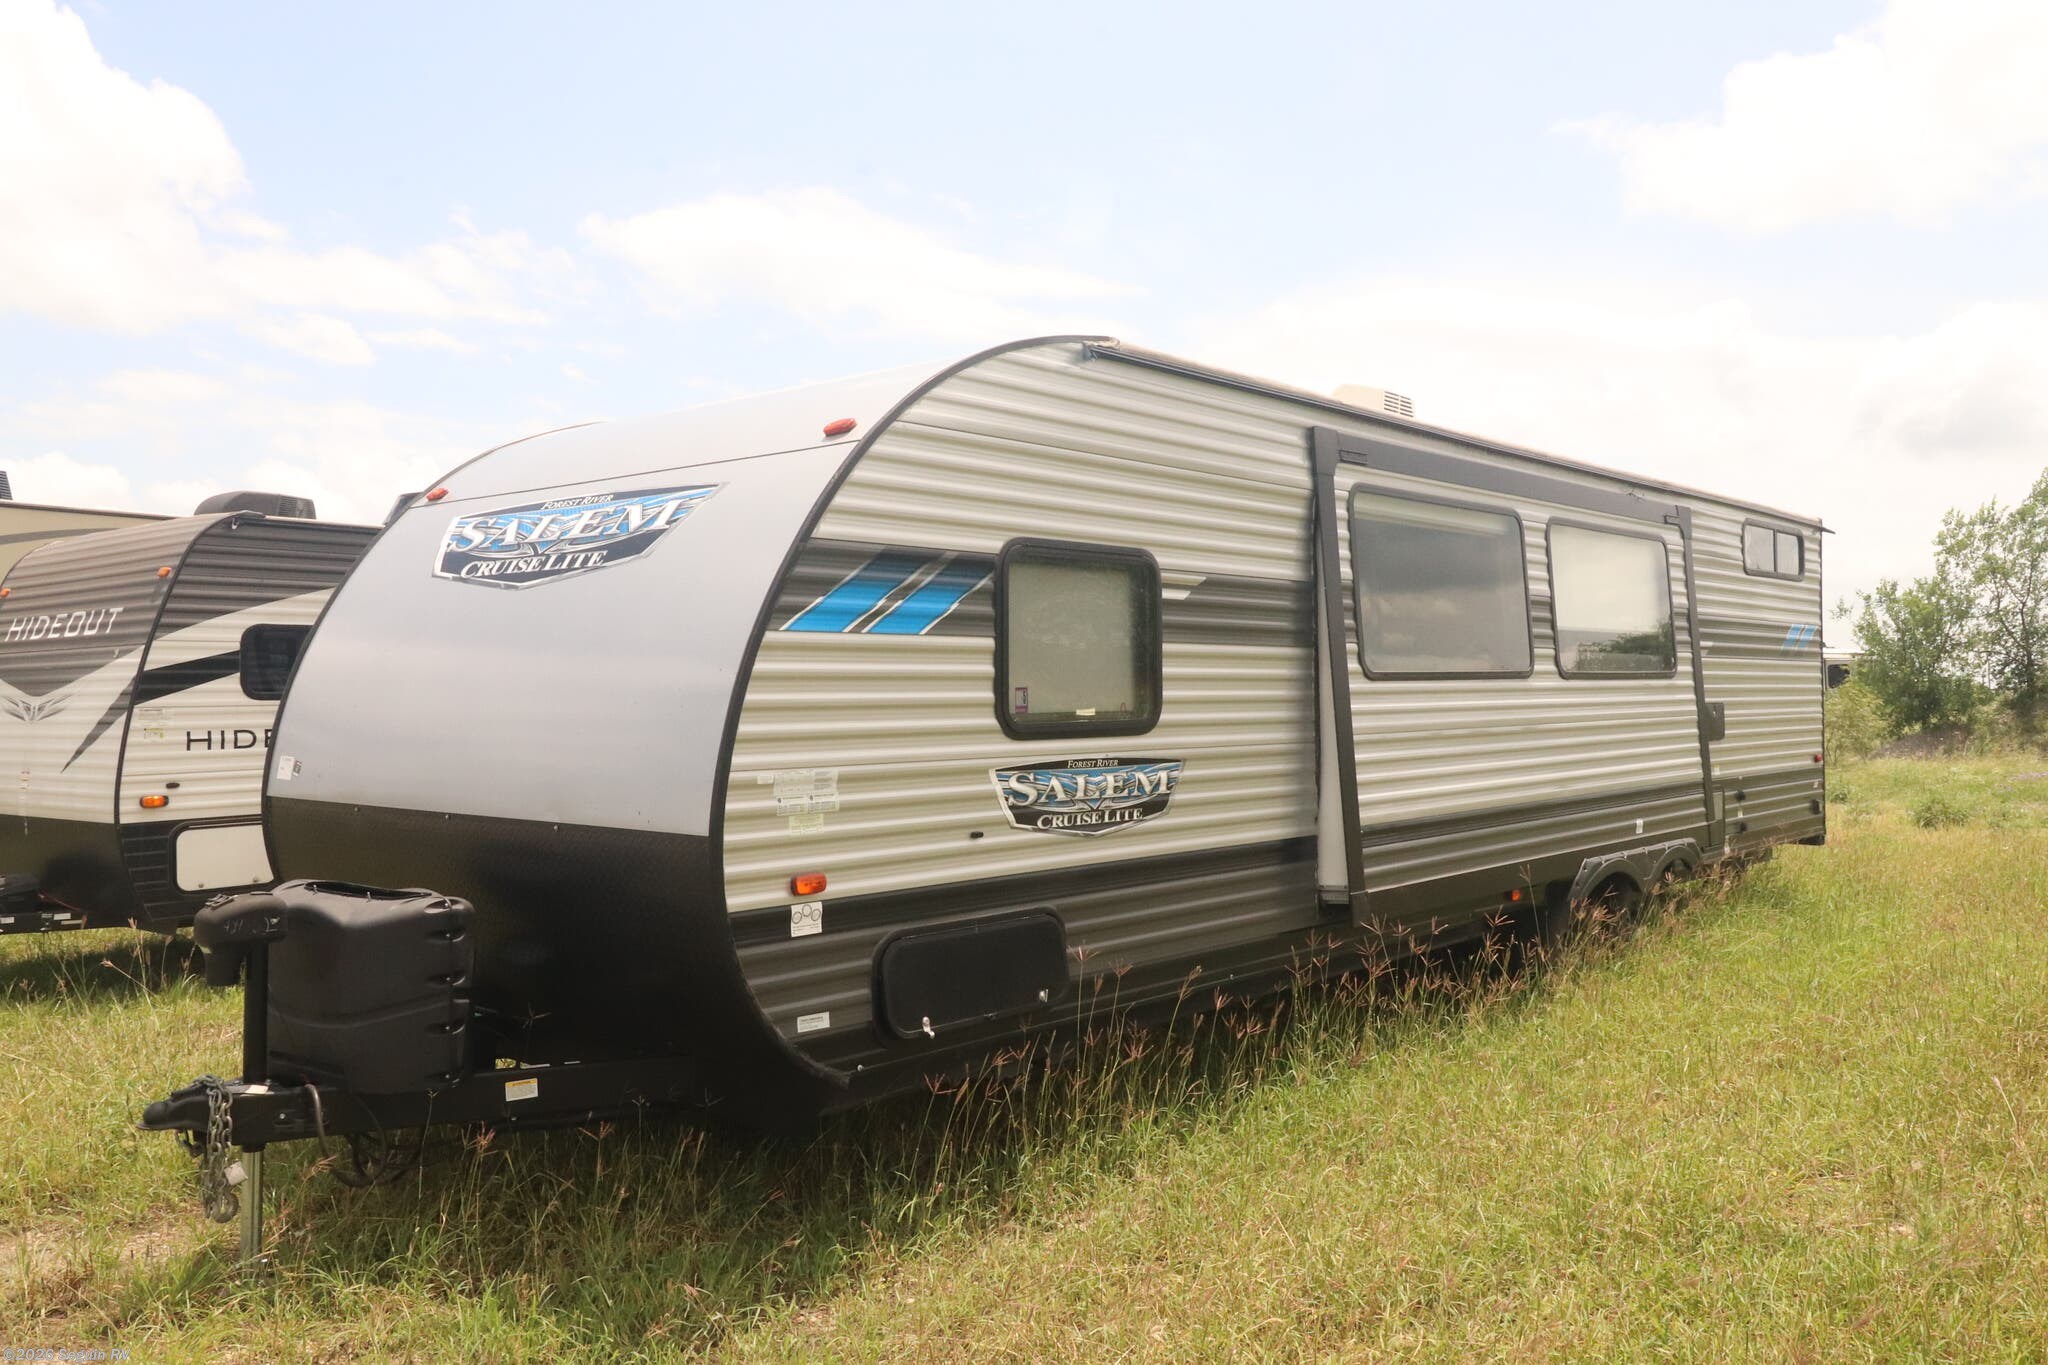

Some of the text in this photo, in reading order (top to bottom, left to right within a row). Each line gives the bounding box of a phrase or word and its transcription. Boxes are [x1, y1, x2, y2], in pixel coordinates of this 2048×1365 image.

[541, 494, 615, 511] FOREST RIVER
[448, 498, 688, 552] SALEM
[460, 550, 609, 580] CRUISE LITE
[4, 606, 124, 643] HIDEOUT
[1067, 759, 1119, 769] FOREST RIVER
[1008, 771, 1171, 807] SALEM
[1036, 808, 1144, 830] CRUISE LITE
